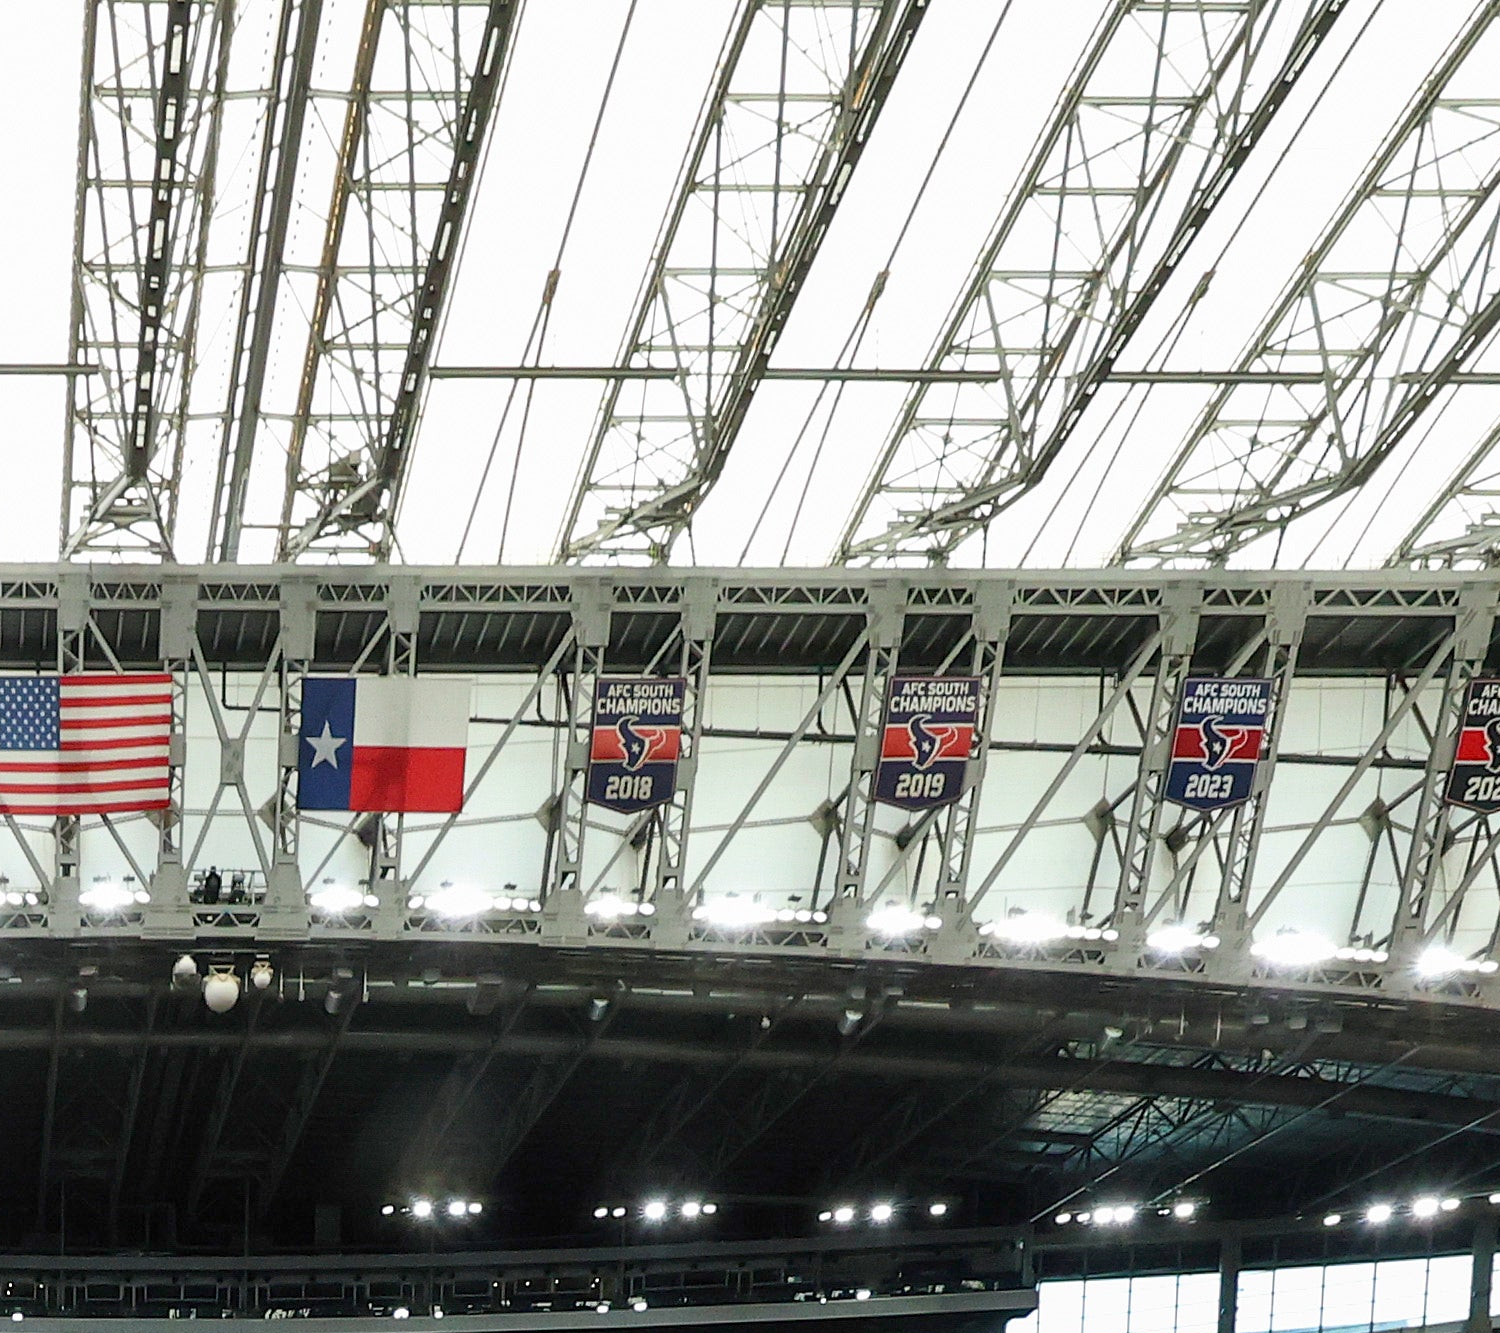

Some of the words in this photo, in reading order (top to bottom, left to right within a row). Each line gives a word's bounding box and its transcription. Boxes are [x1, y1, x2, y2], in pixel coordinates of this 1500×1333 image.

[608, 684, 631, 698] AFC
[634, 684, 674, 698] SOUTH
[902, 682, 926, 696] AFC
[928, 682, 969, 695] SOUTH
[1195, 684, 1220, 697] AFC
[1220, 684, 1260, 697] SOUTH
[598, 698, 680, 714] CHAMPIONS
[891, 696, 976, 712] CHAMPIONS
[1184, 698, 1266, 714] CHAMPIONS
[605, 776, 653, 800] 2018
[895, 773, 946, 798] 2019
[1184, 774, 1234, 798] 2023
